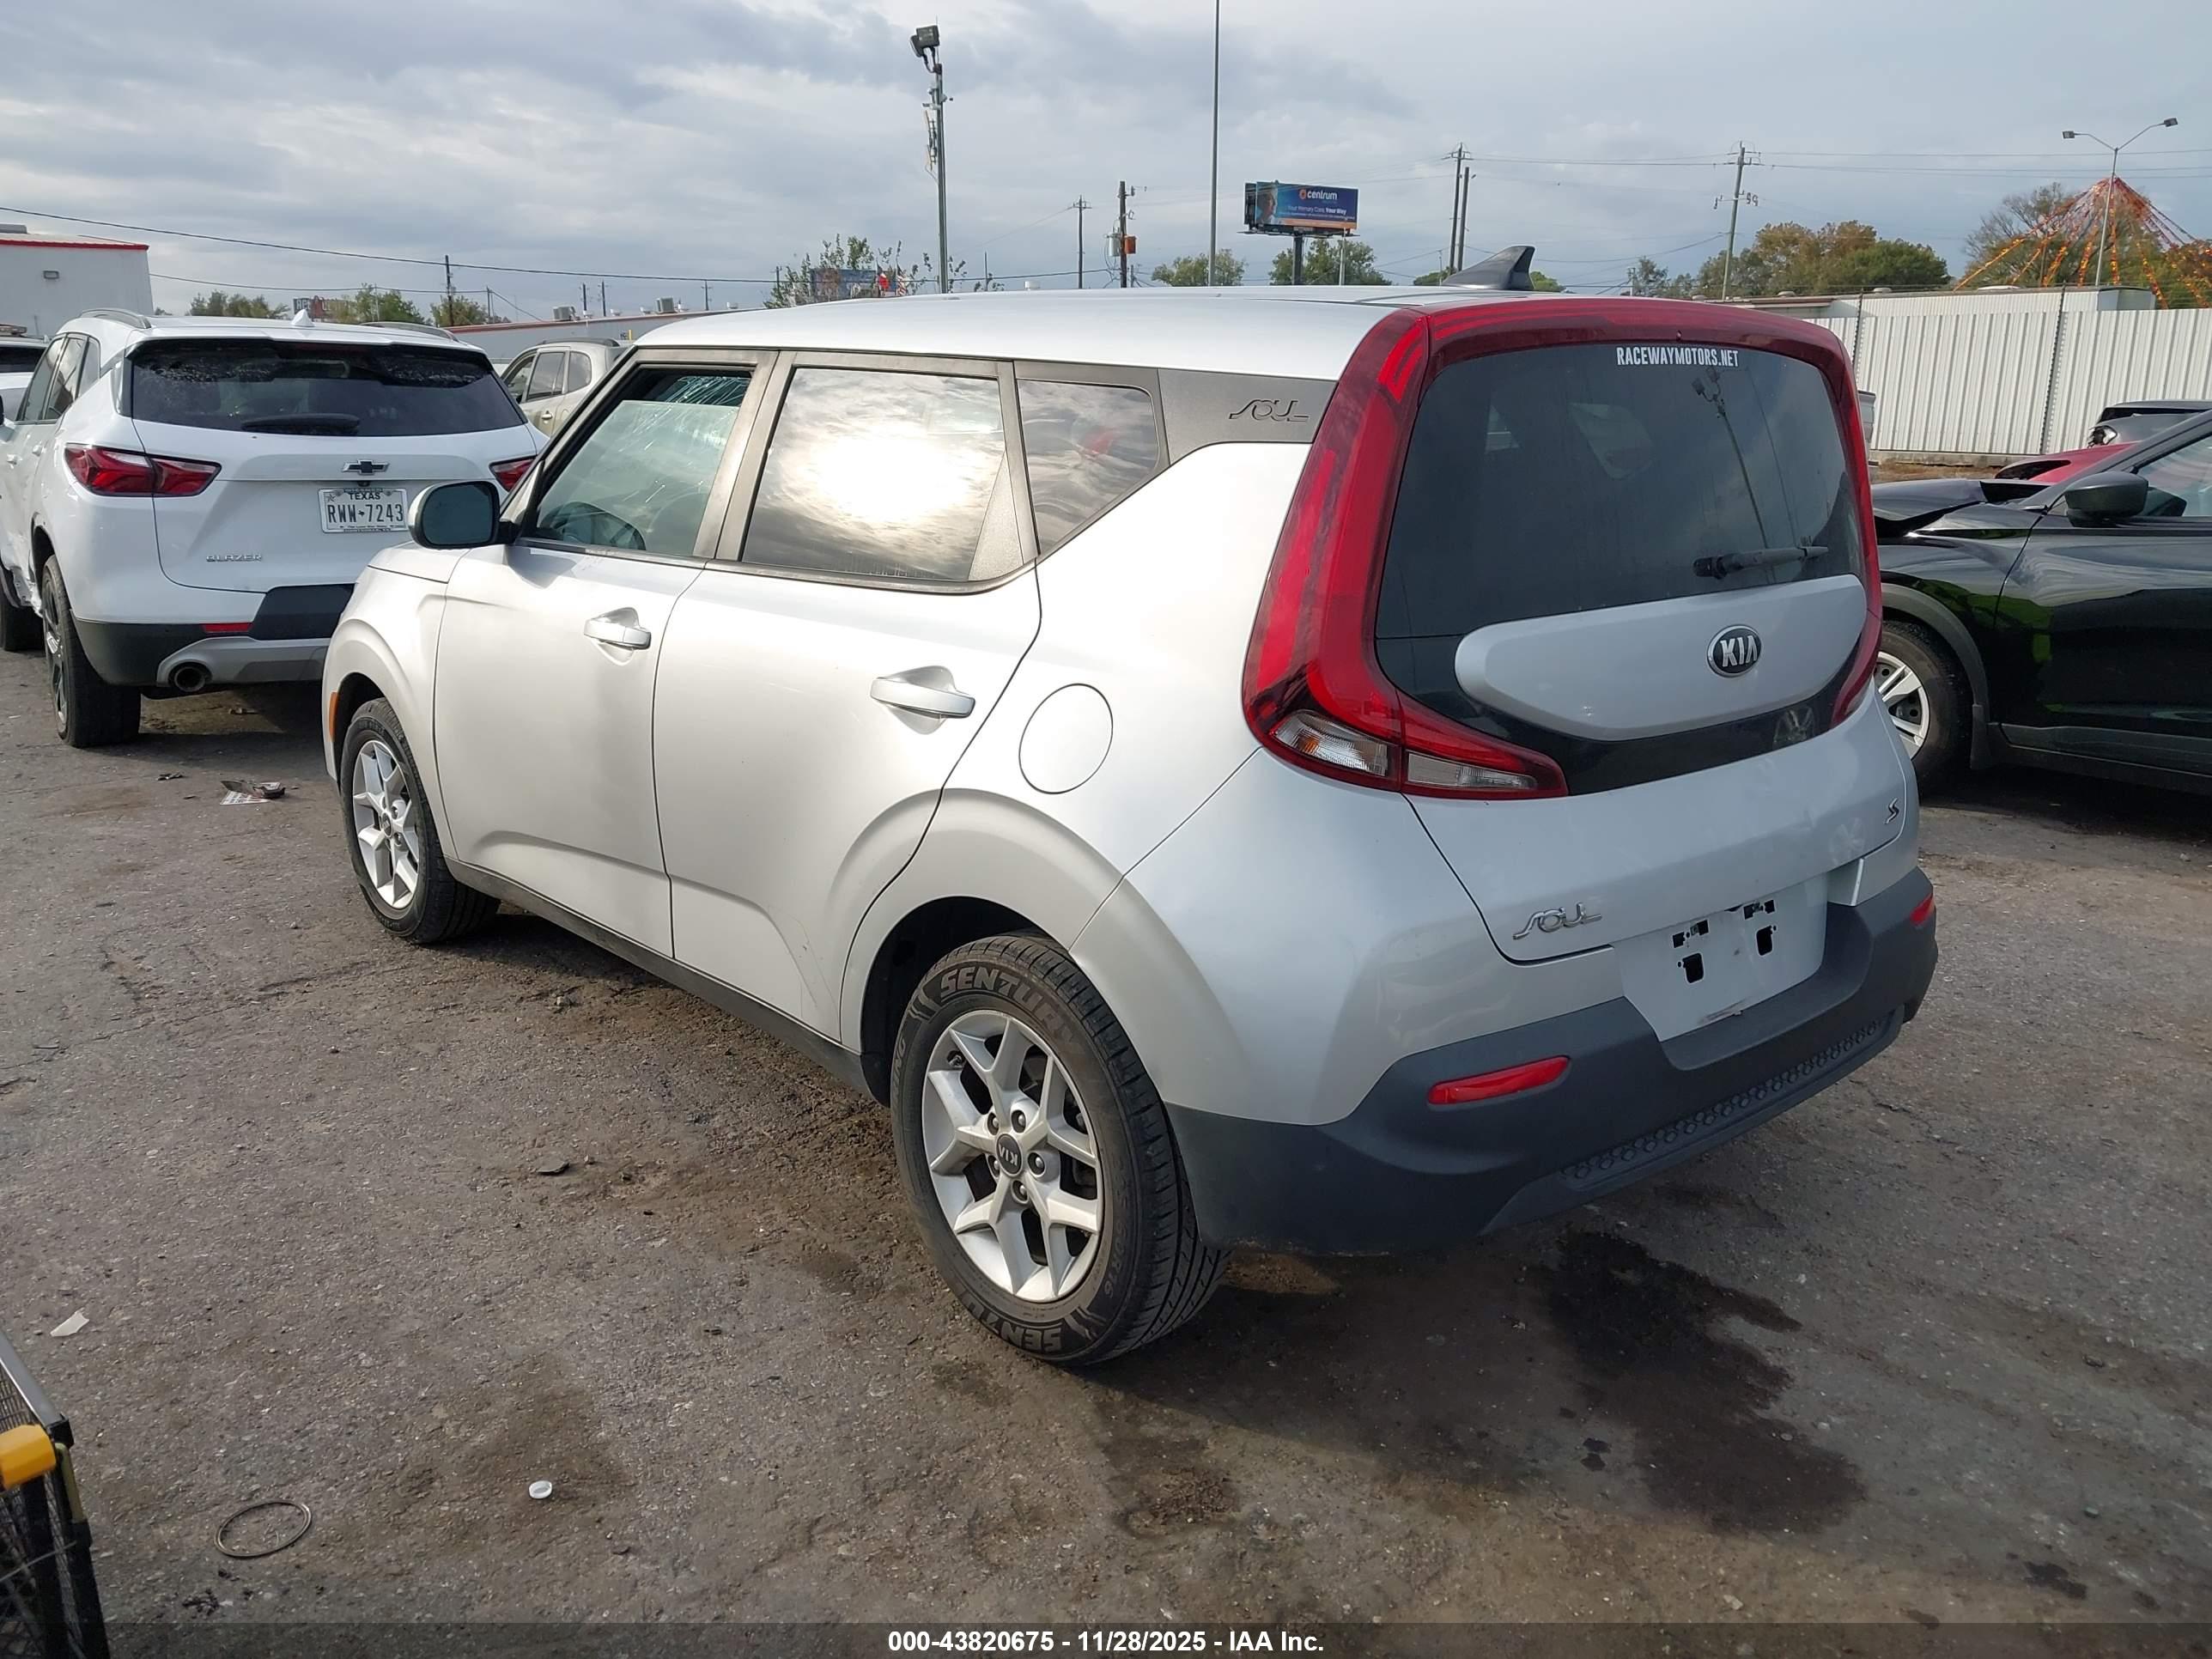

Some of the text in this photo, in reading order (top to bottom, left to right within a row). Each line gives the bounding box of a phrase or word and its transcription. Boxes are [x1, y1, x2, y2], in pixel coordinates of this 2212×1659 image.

[1307, 189, 1338, 200] centrum
[1616, 346, 1739, 368] RACEWAYMOTORS.NET
[349, 492, 381, 501] TEXAS
[206, 554, 262, 562] BLAZER
[1719, 635, 1758, 667] KIA
